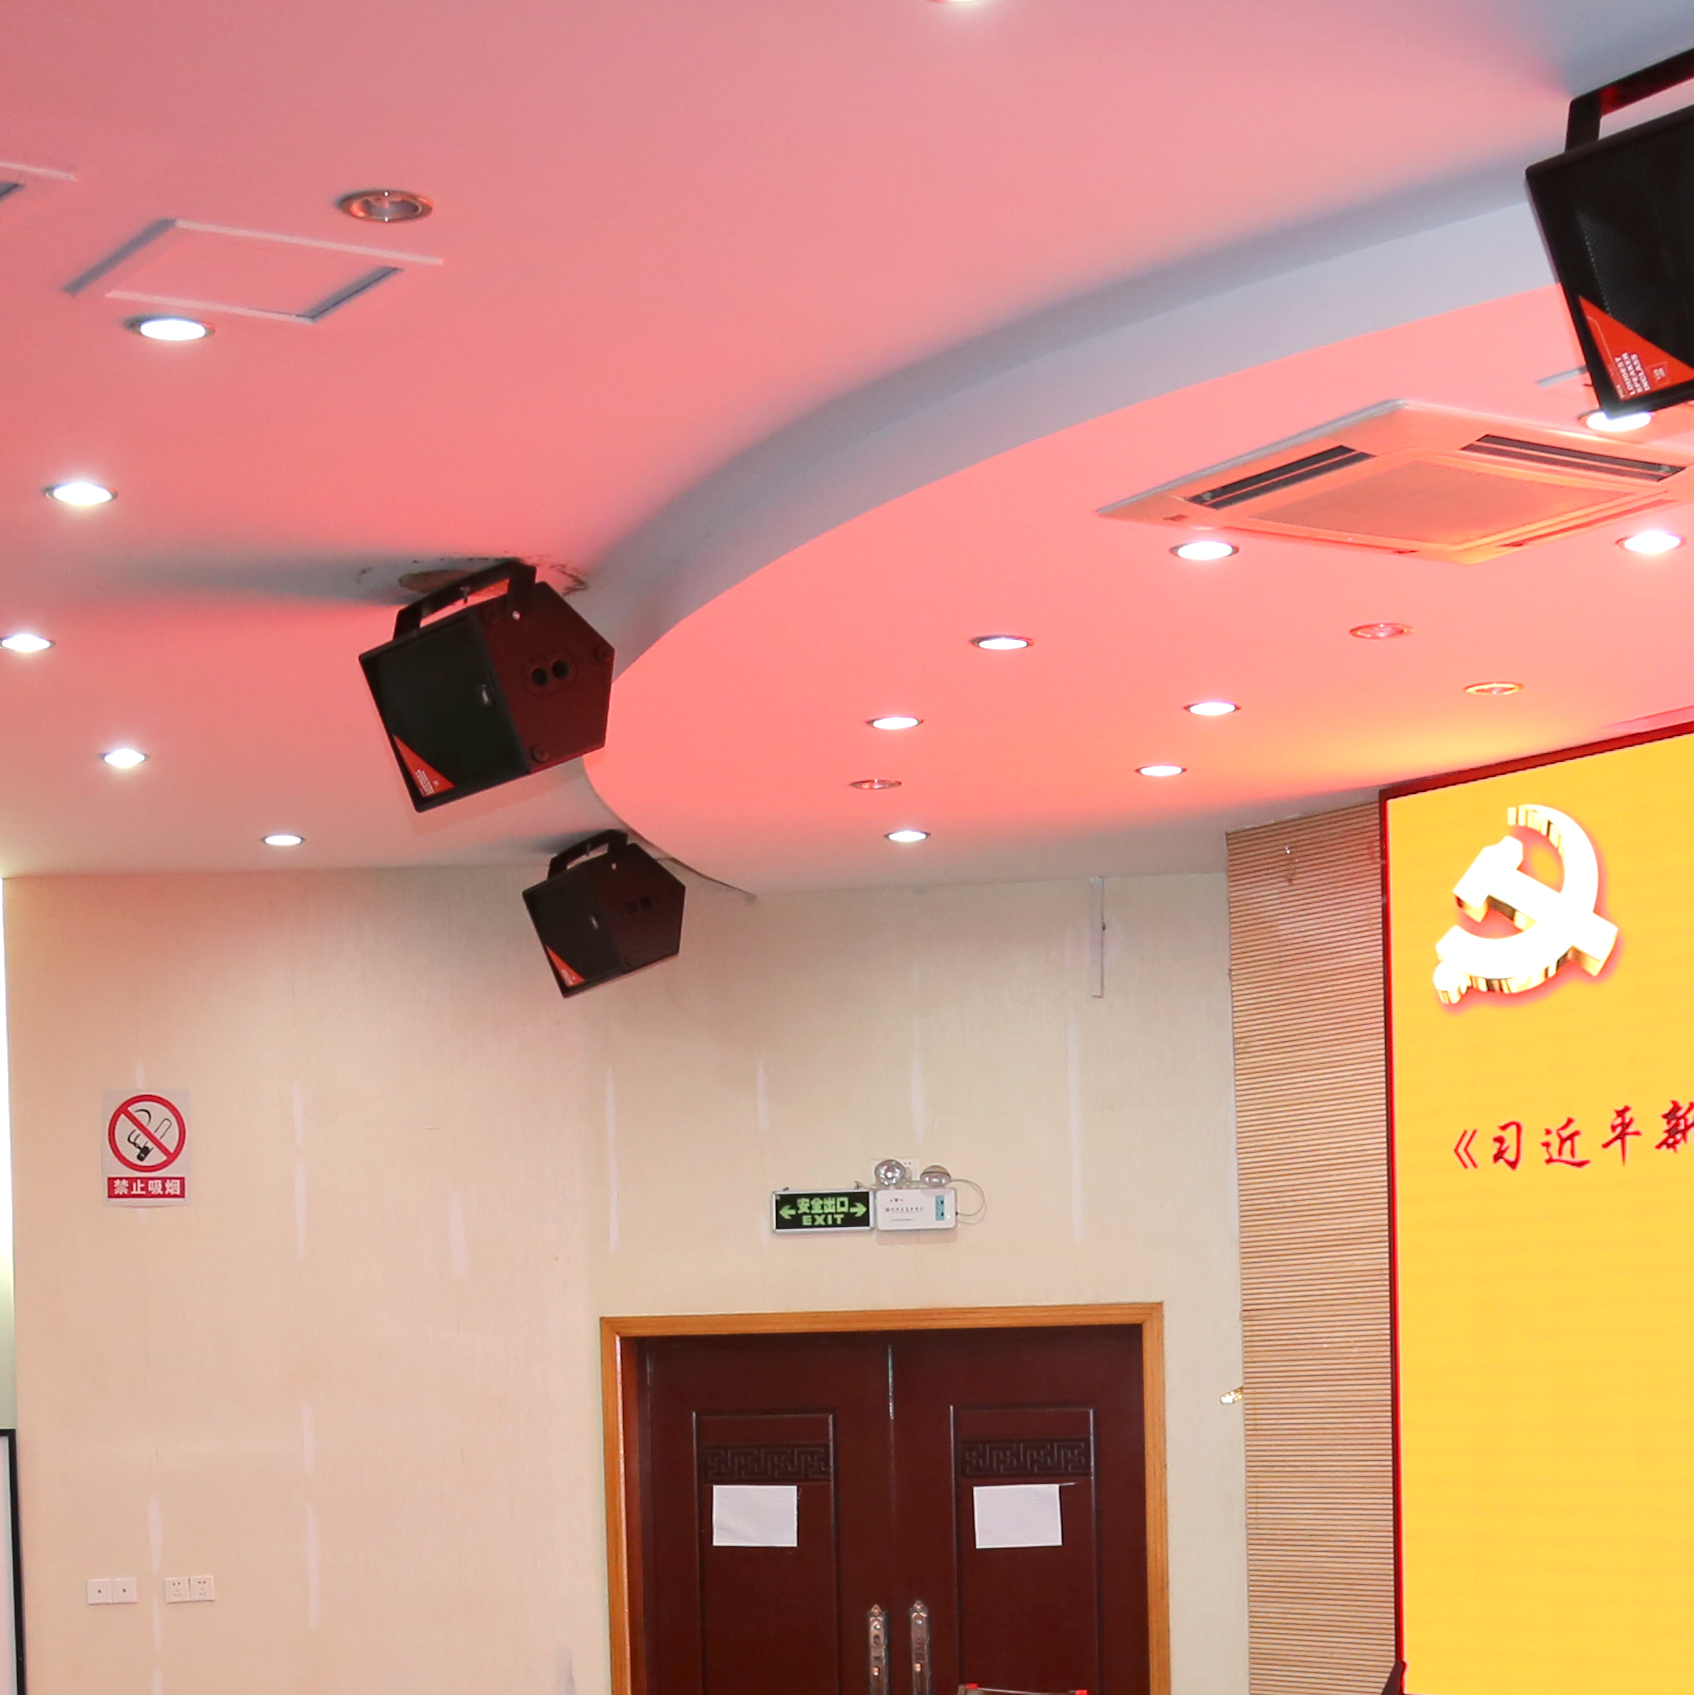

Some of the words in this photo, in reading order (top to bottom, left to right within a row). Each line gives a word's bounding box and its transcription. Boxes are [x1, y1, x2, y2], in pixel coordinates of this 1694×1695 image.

[113, 1179, 181, 1195] 禁止吸烟
[797, 1197, 849, 1214] 安全出口
[802, 1214, 846, 1226] EXIT
